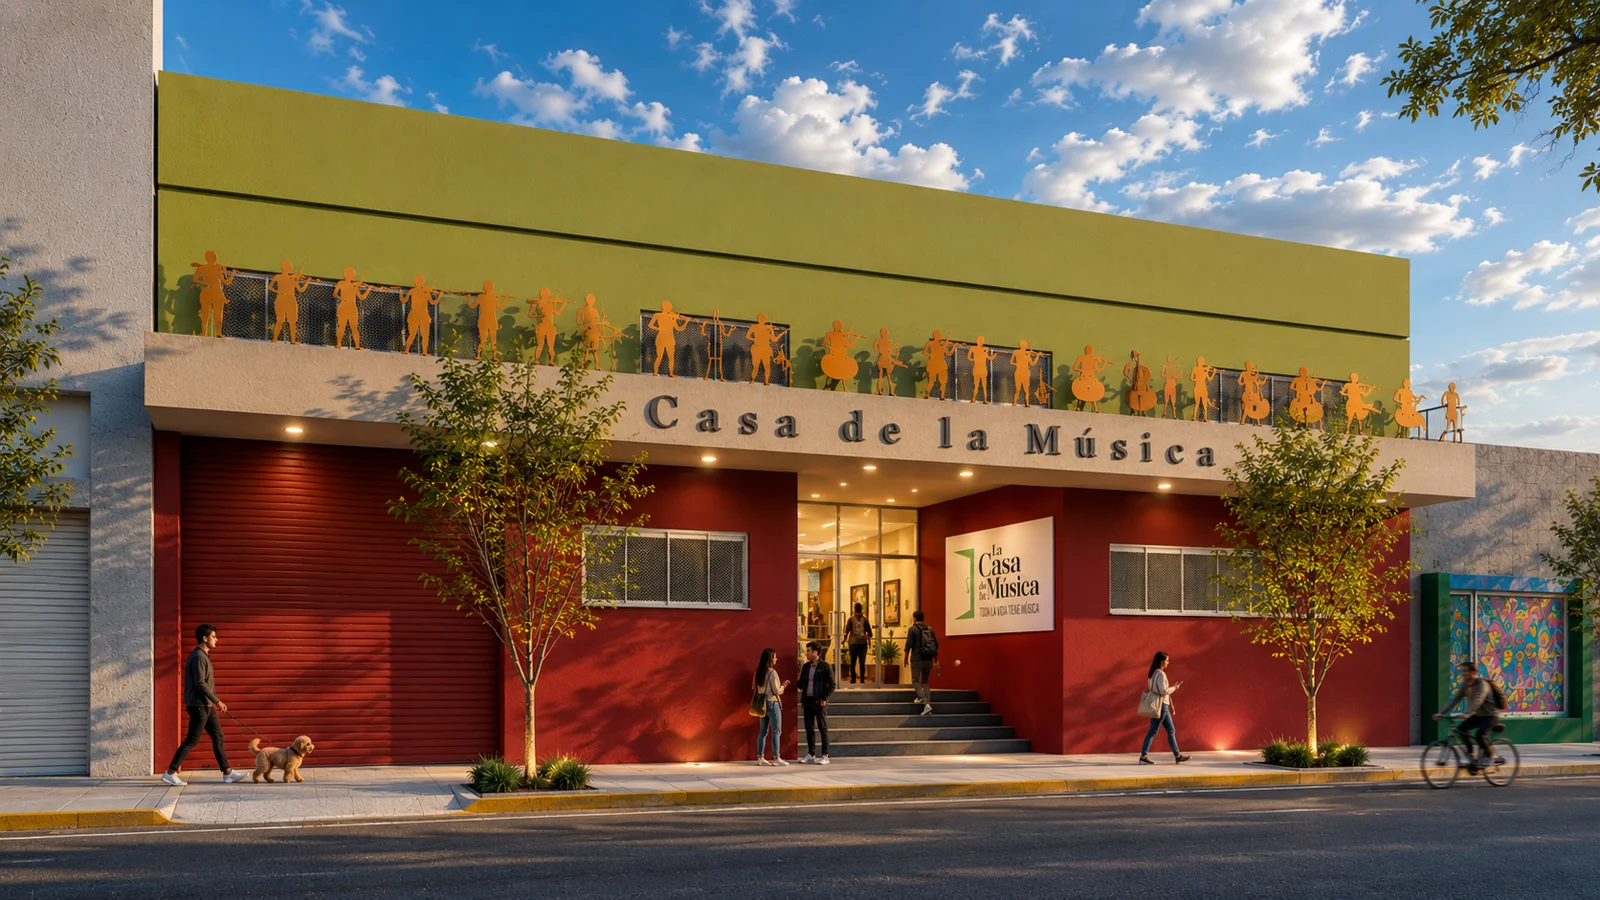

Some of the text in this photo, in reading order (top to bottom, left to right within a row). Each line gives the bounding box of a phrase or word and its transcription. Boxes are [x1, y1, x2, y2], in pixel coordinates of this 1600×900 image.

[644, 395, 1217, 467] Casa de la Música
[992, 544, 1002, 556] La
[979, 552, 1021, 577] Casa
[987, 576, 1040, 599] Música
